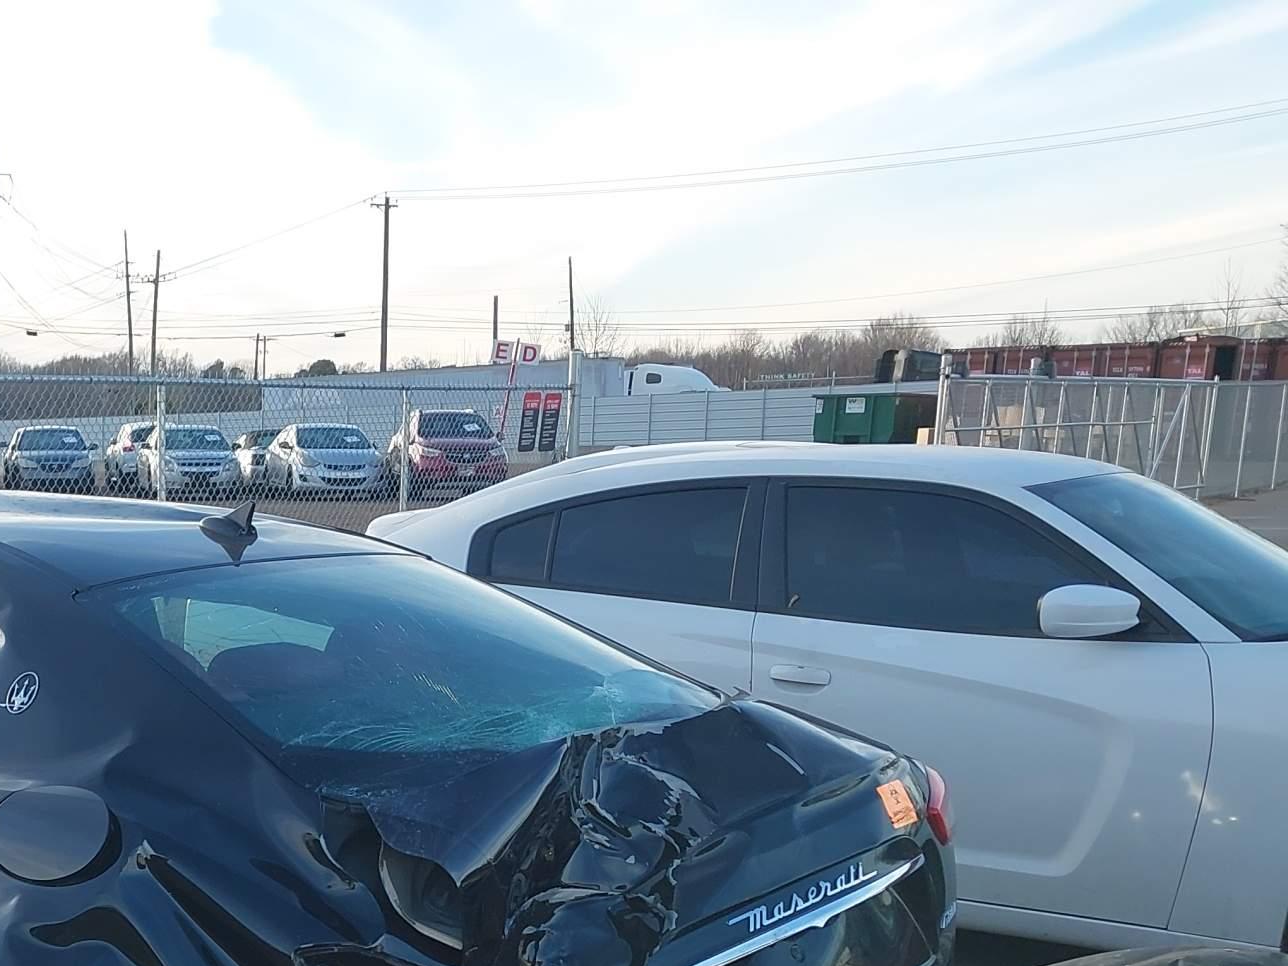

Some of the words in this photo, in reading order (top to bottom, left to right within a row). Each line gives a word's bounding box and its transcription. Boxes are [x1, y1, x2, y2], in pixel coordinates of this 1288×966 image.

[495, 342, 510, 359] E
[522, 345, 537, 362] D
[727, 862, 878, 932] Maserati
